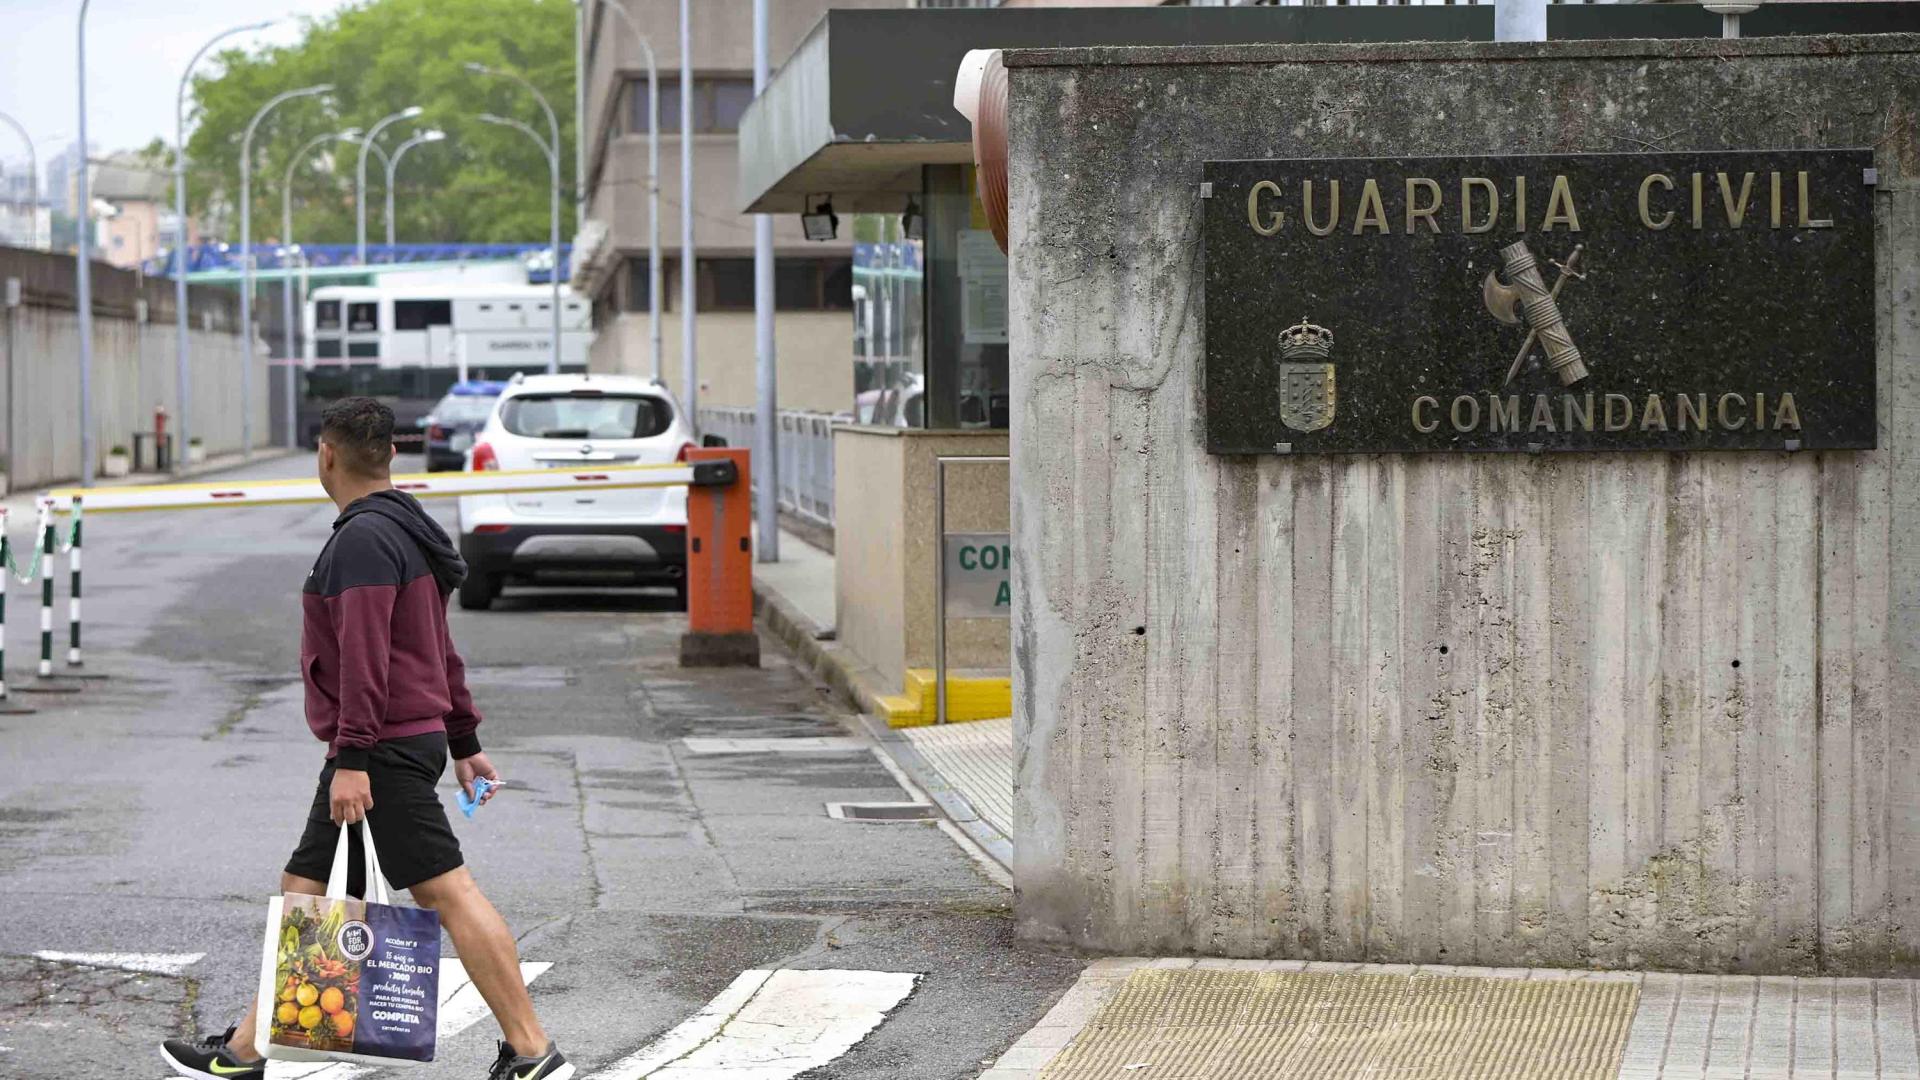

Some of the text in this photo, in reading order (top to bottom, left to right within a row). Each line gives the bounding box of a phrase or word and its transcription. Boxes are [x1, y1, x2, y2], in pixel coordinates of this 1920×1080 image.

[1247, 170, 1835, 237] GUARDIA CIVIL
[1411, 390, 1802, 434] COMANDANCIA
[347, 943, 366, 952] FOOD
[367, 959, 433, 974] EL MERCADO BIO
[372, 1011, 420, 1024] COMPLETA
